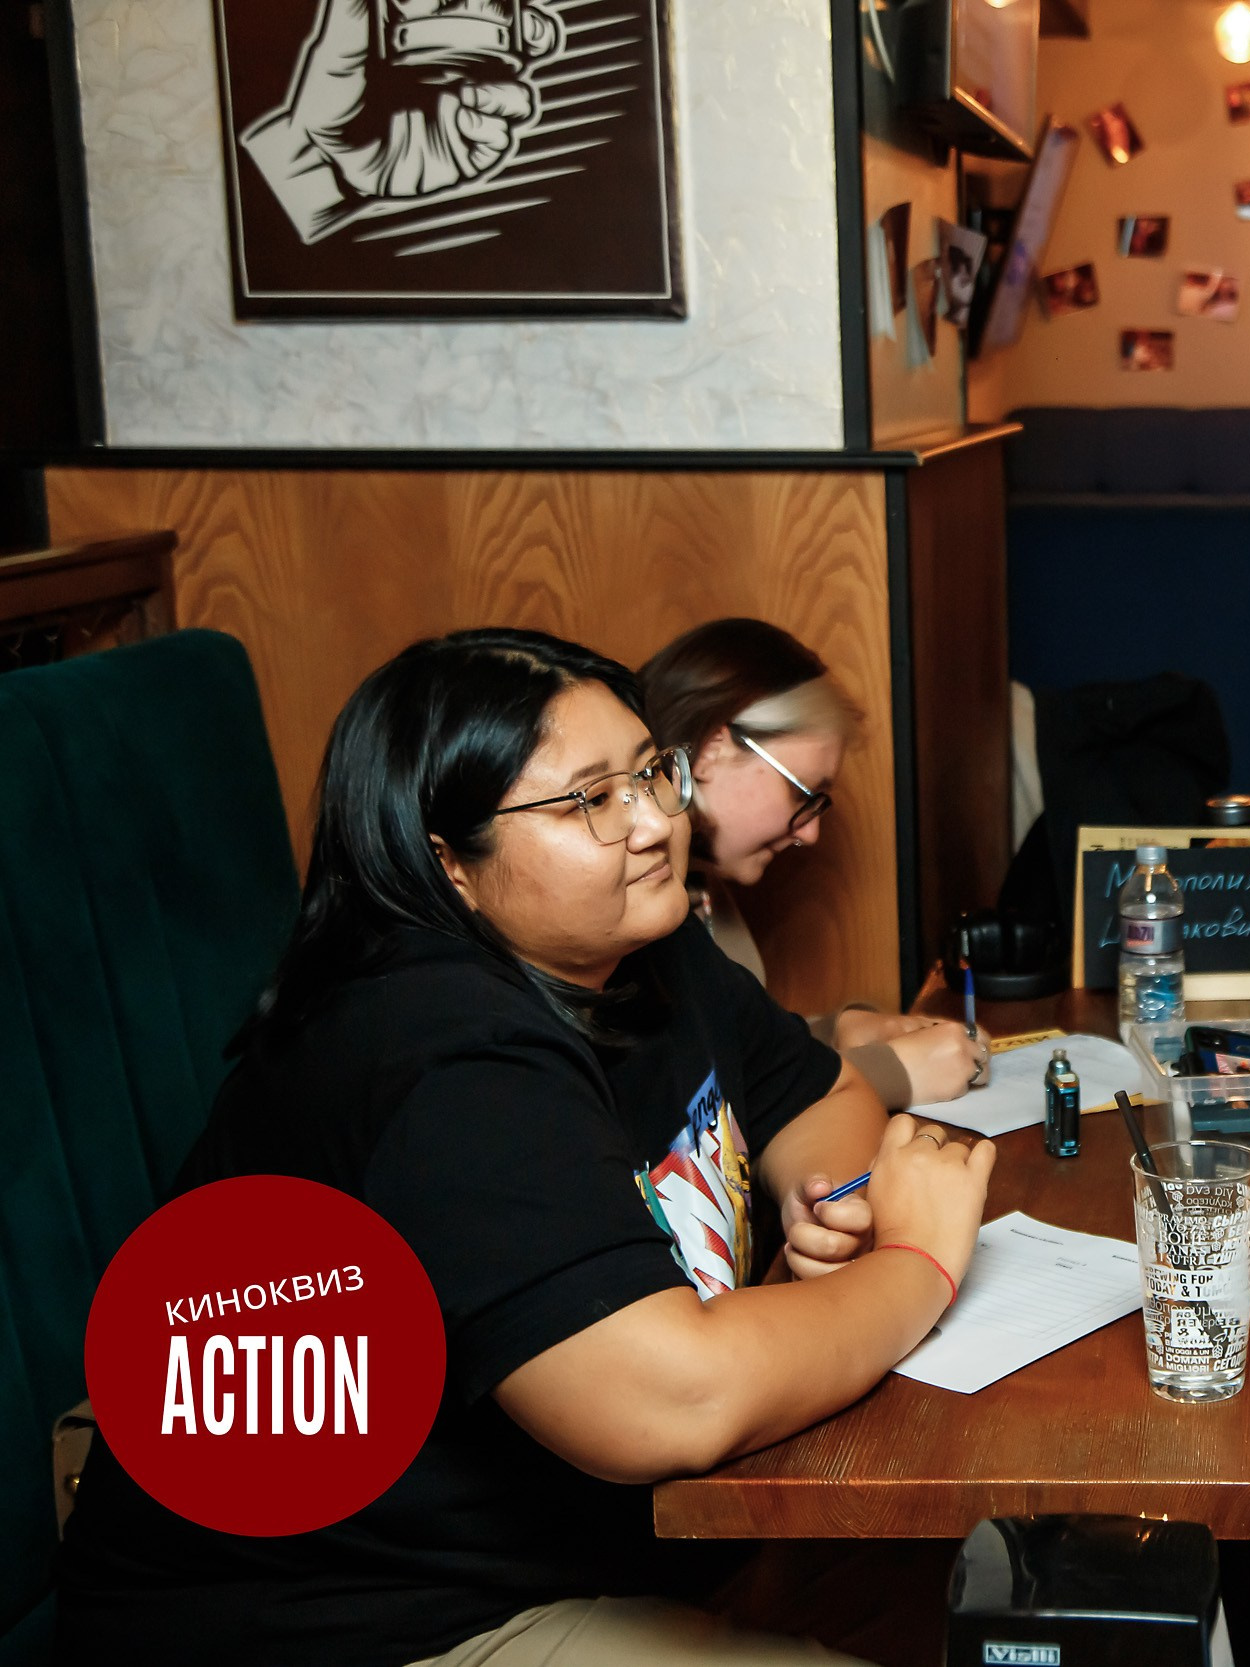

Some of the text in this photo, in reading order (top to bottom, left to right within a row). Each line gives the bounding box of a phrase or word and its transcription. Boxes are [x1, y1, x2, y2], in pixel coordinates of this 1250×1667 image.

[1145, 1275, 1177, 1295] TODAY
[1180, 1285, 1190, 1297] &
[1165, 1353, 1210, 1365] DOMANI
[1166, 1362, 1210, 1373] MIGLIORI
